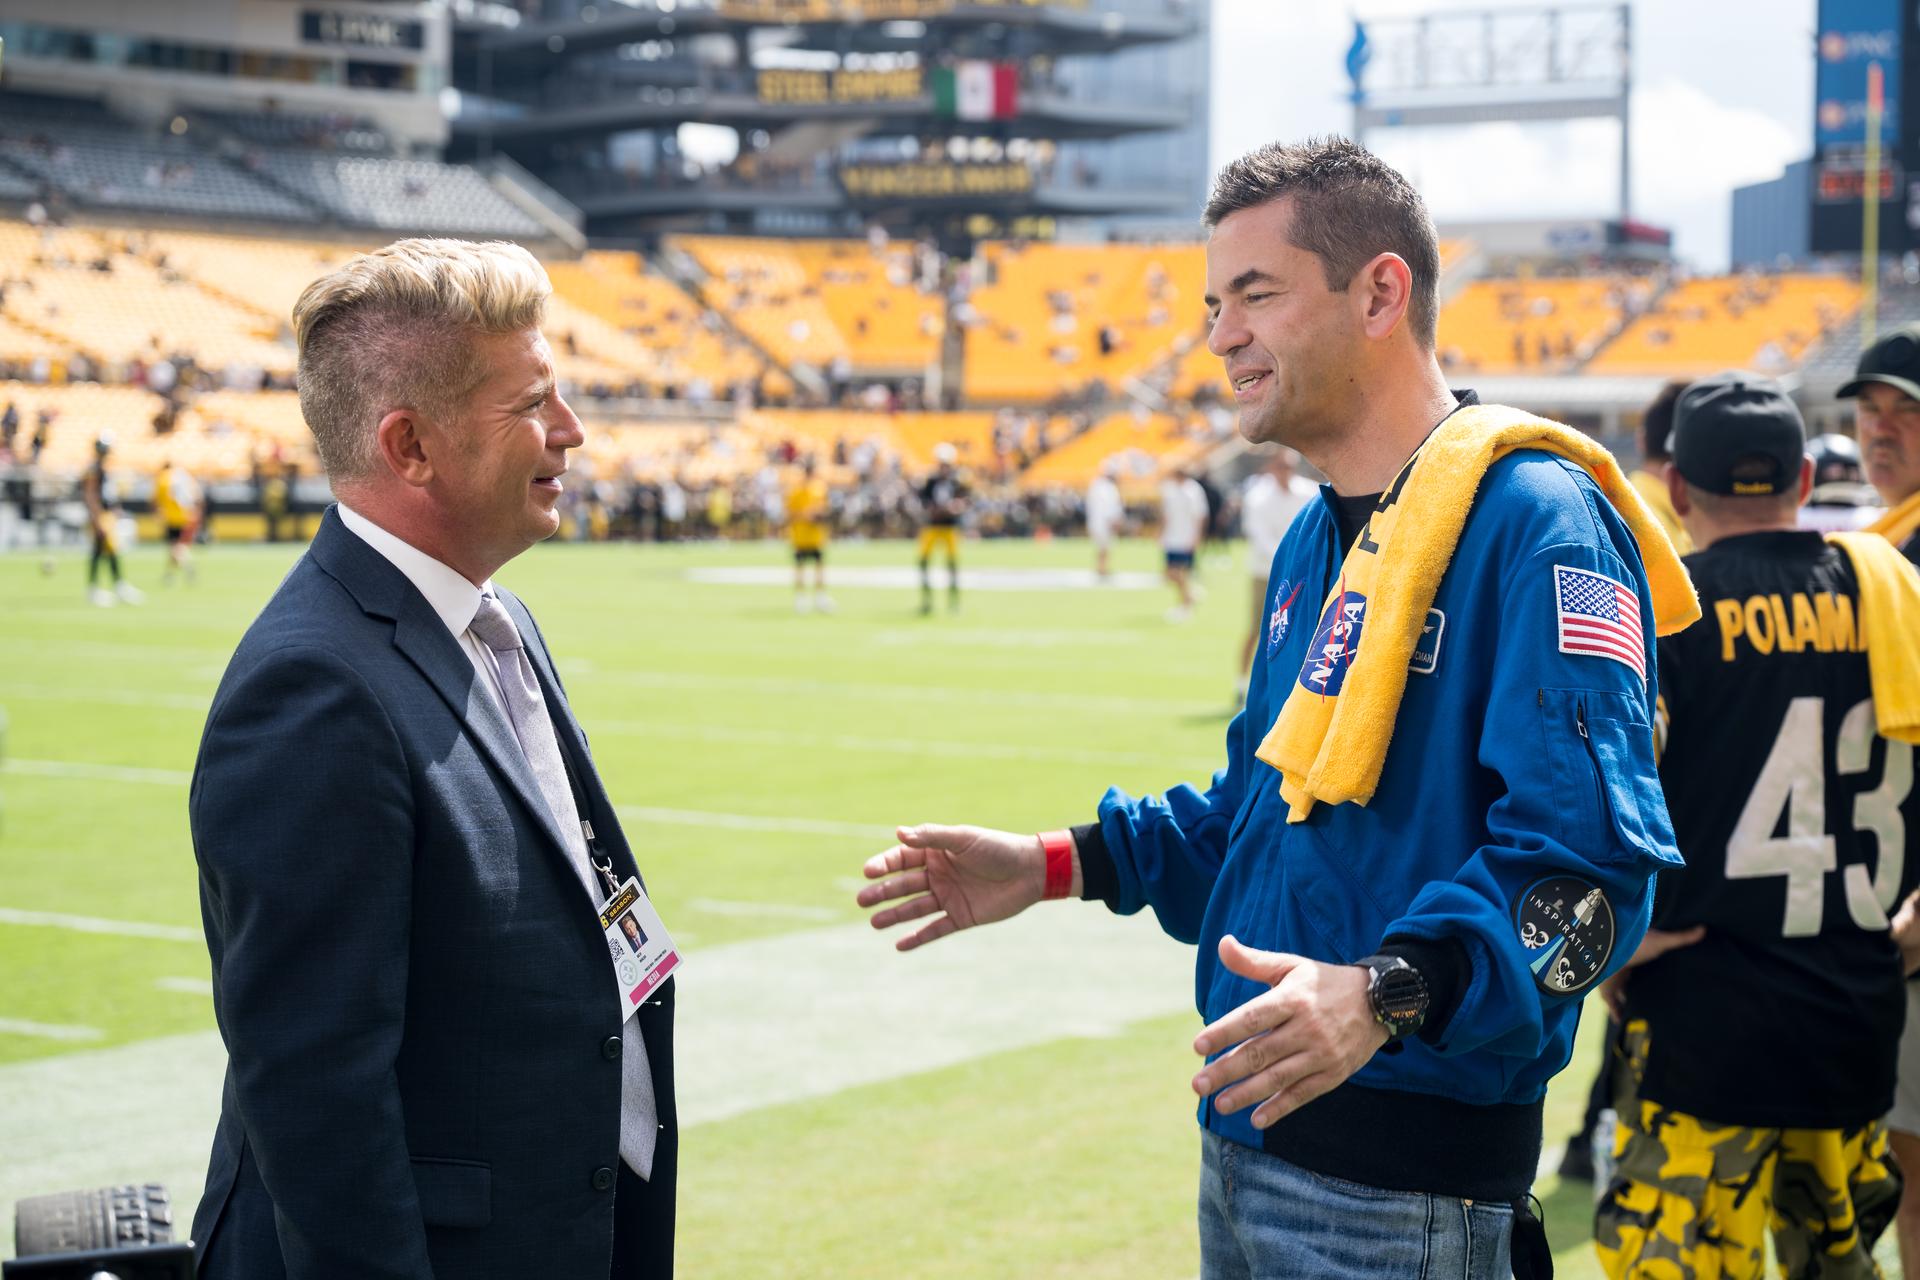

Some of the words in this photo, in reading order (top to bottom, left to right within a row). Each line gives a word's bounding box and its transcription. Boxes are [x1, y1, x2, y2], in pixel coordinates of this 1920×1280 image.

[1308, 602, 1366, 688] NASA
[1415, 650, 1433, 664] CMAN
[1725, 697, 1914, 938] 43
[609, 894, 632, 918] SEASON
